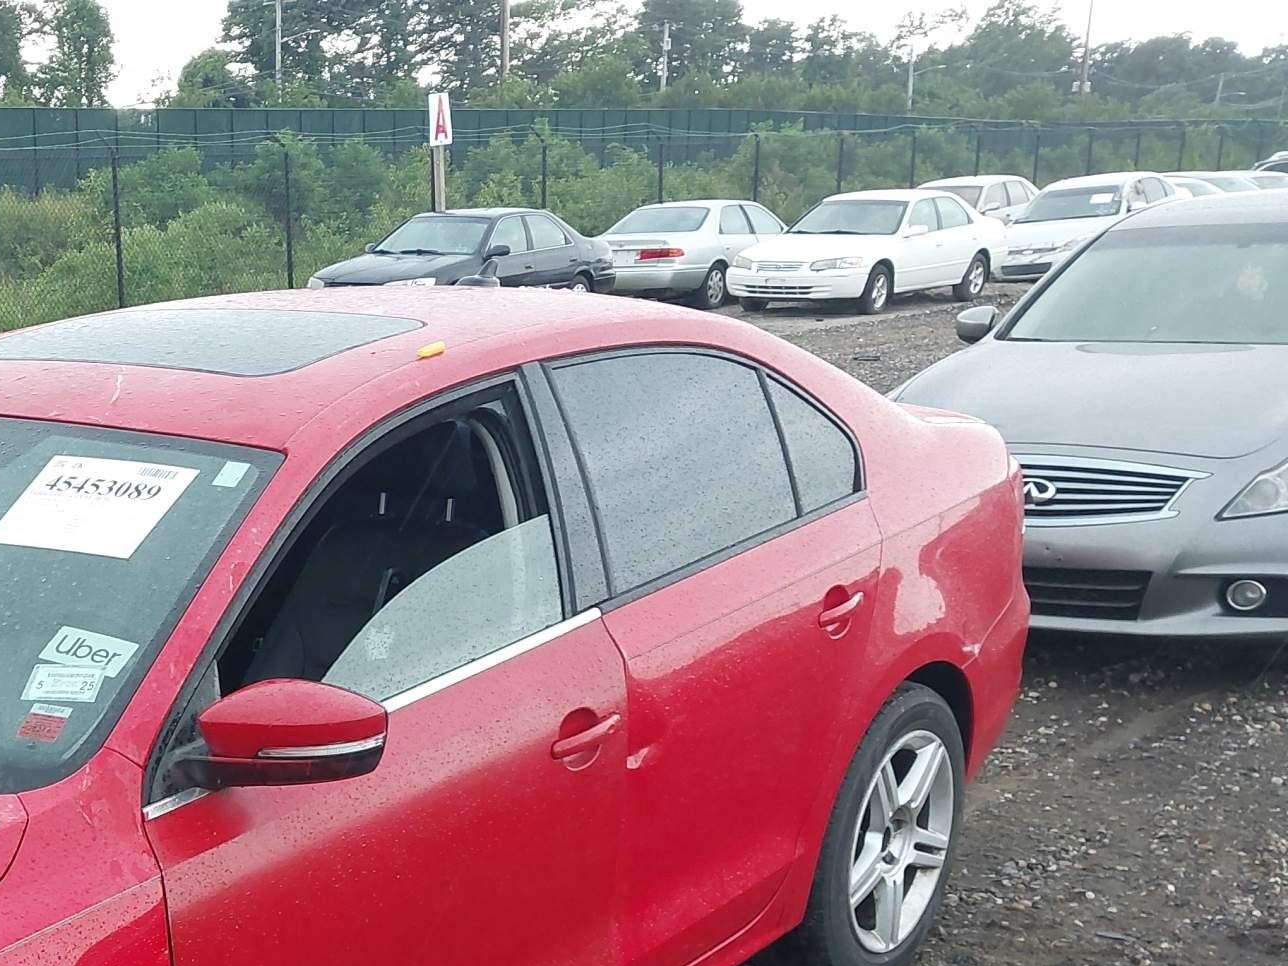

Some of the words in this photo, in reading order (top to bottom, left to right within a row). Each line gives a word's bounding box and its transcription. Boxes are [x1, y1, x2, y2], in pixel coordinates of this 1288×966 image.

[434, 95, 448, 141] A
[44, 474, 162, 501] 45453089
[55, 634, 123, 666] Uber
[36, 680, 45, 690] 5
[79, 680, 96, 691] 25
